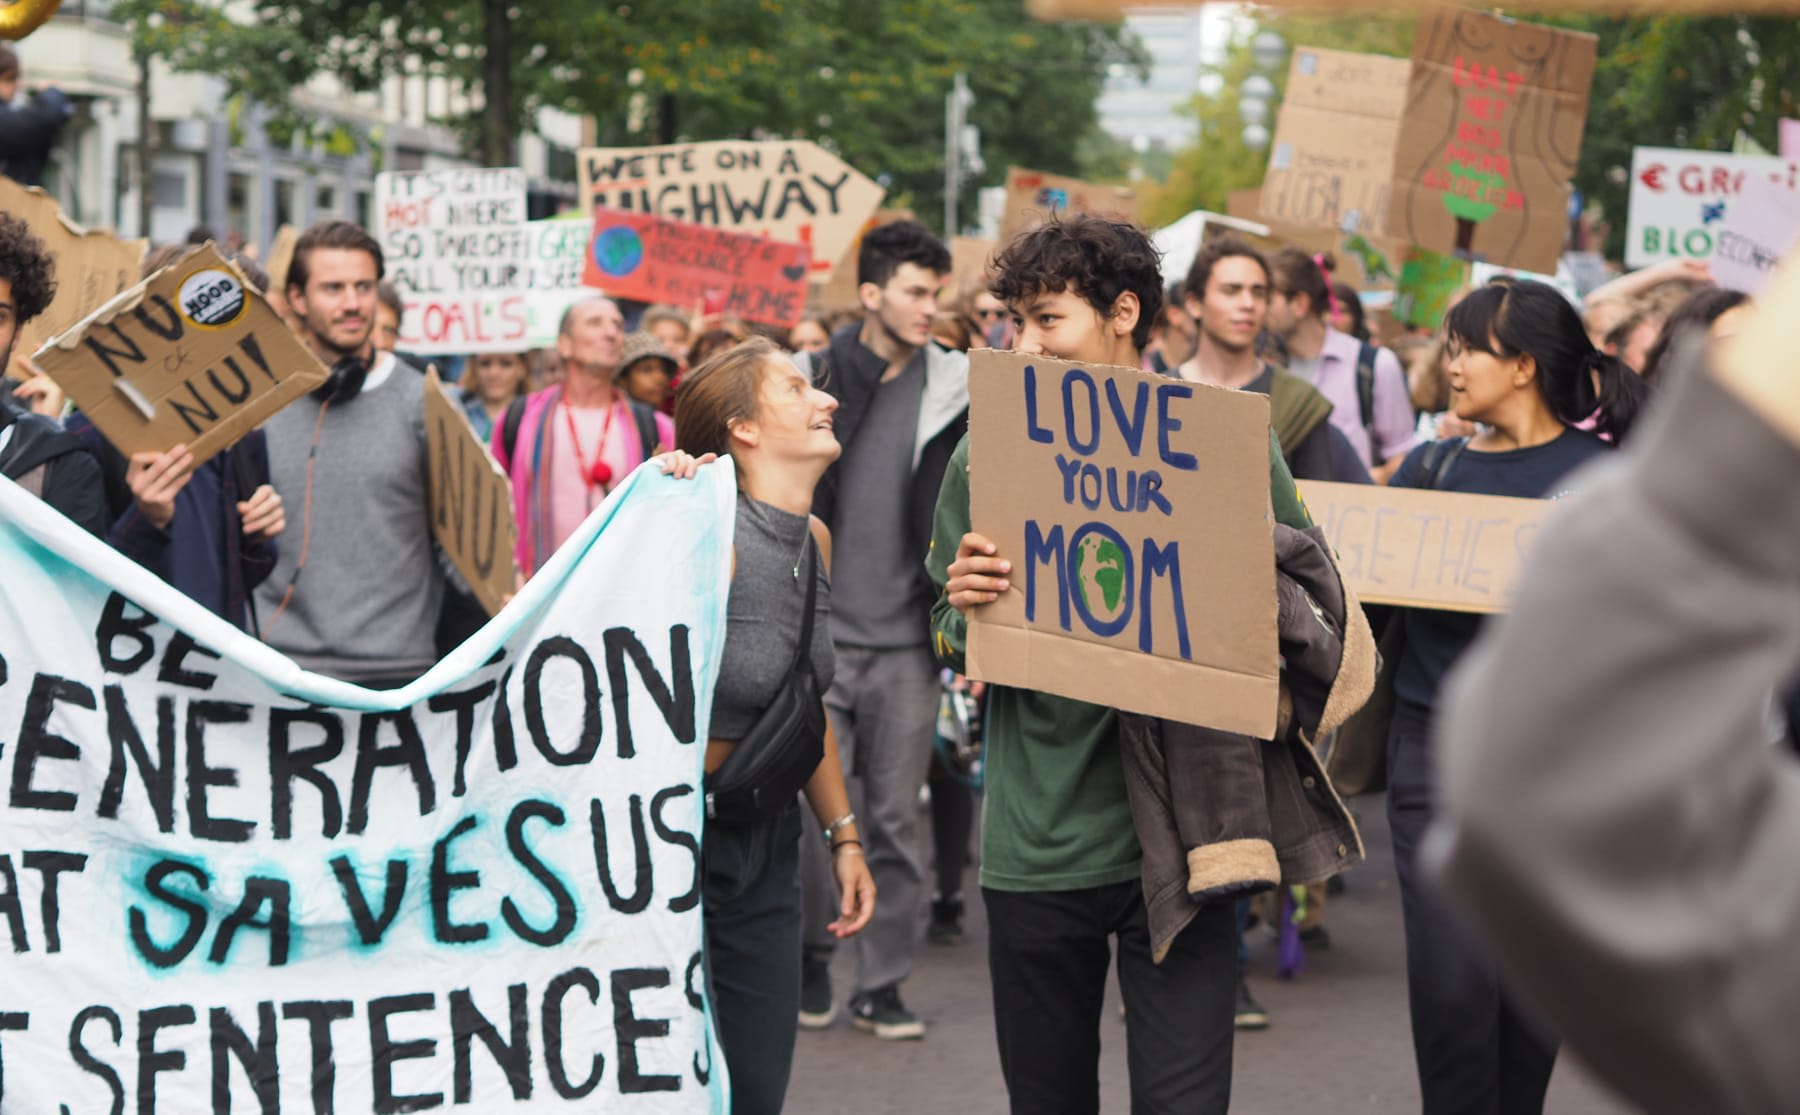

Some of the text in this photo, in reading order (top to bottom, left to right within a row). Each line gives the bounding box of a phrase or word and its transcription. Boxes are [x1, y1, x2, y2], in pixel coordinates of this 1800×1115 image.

[716, 149, 762, 171] ON
[777, 149, 800, 174] A
[386, 198, 433, 228] HOT
[386, 230, 422, 260] SO
[393, 262, 520, 293] ALL YOUR
[167, 331, 281, 435] NU!
[1023, 364, 1199, 471] LOVE
[1054, 453, 1172, 516] YOUR
[1024, 519, 1193, 660] MOM
[1410, 510, 1509, 595] THE
[96, 589, 222, 690] BE
[0, 622, 697, 842] ENERATION
[128, 798, 578, 969] SAVES
[590, 783, 701, 914] US
